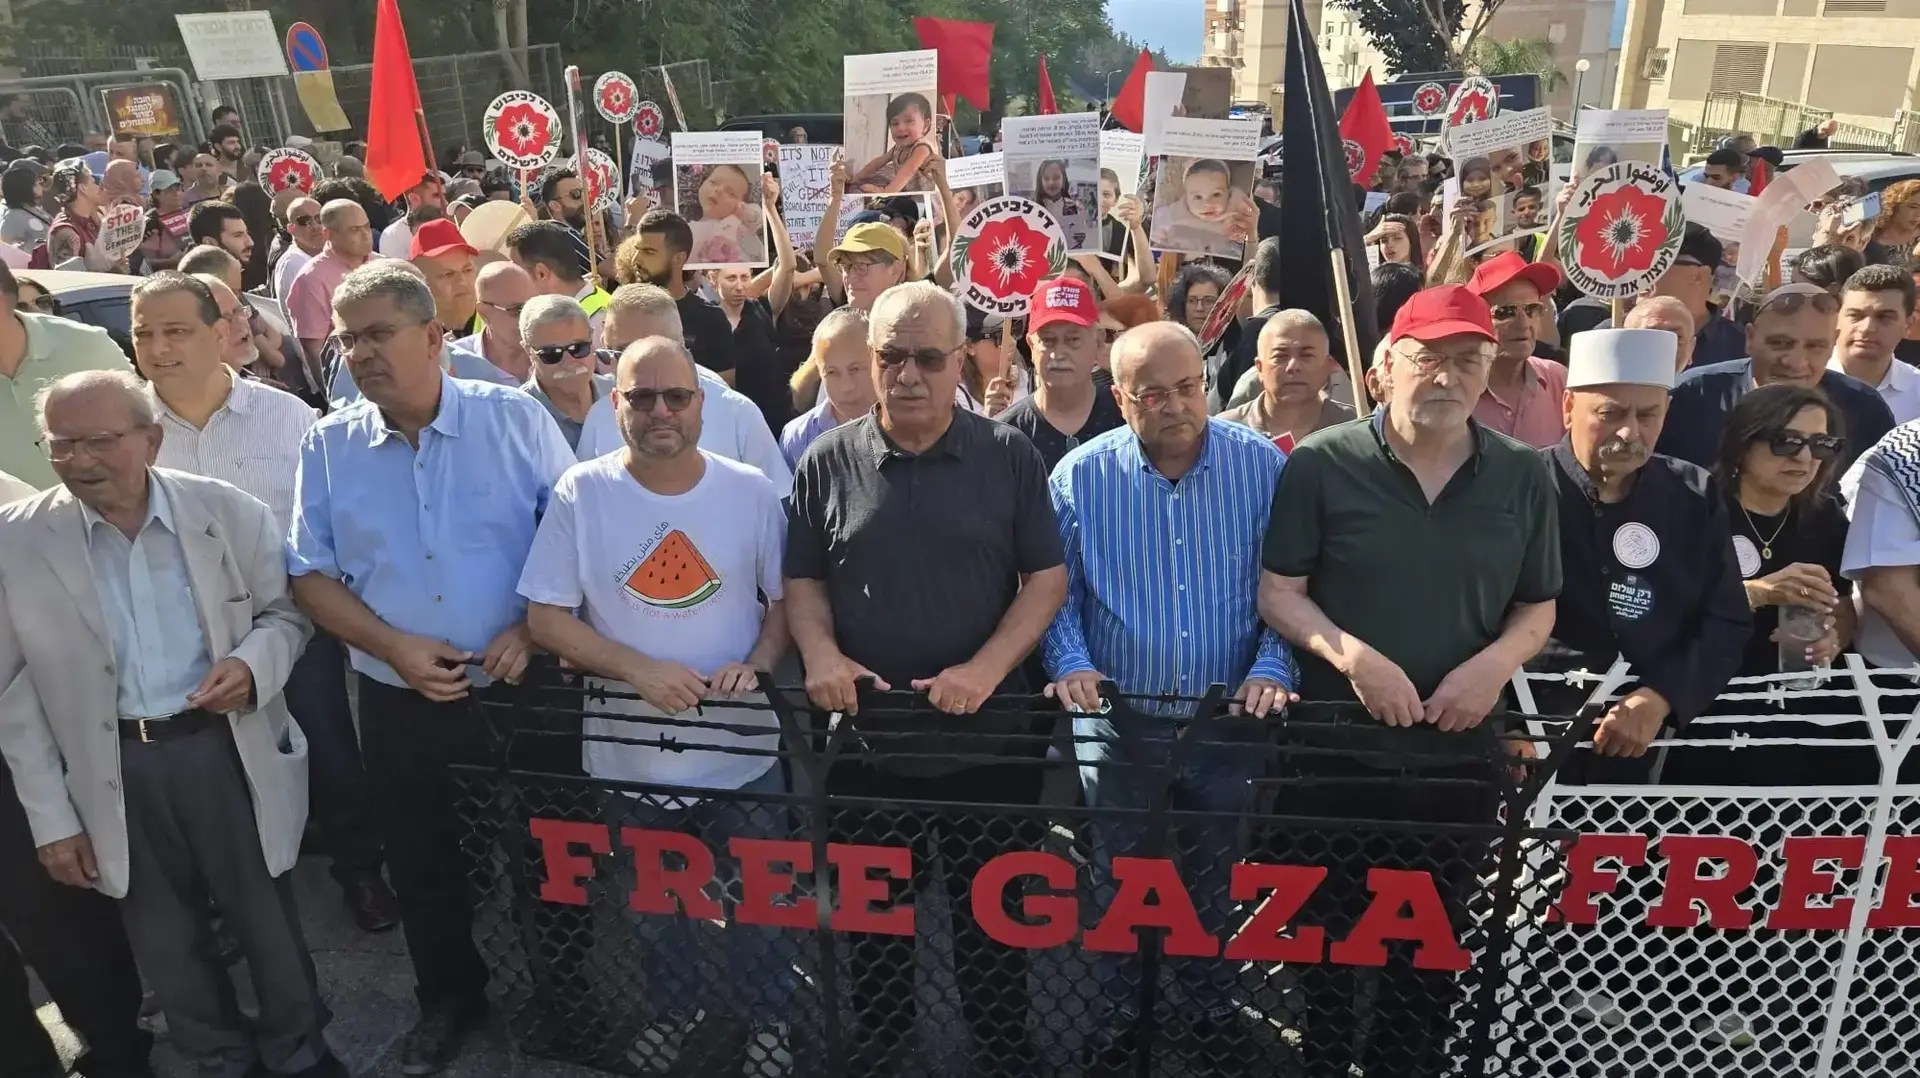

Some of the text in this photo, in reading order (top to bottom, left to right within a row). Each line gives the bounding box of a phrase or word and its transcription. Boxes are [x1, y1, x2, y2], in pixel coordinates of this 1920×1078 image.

[492, 92, 551, 112] די לכיבוש
[496, 148, 539, 167] לשלום
[540, 149, 552, 163] כן
[780, 147, 803, 162] IT'S
[810, 147, 831, 162] NOT
[1578, 164, 1620, 208] الحرب
[785, 201, 828, 212] SCHOLASTICID
[966, 200, 1055, 230] די לכיבוש
[107, 209, 140, 229] STOP
[115, 223, 134, 237] THE
[1567, 247, 1673, 298] לעצור את המלחמה
[966, 285, 1027, 313] לשלום
[1046, 298, 1080, 308] WAR
[637, 537, 654, 560] مش
[614, 557, 637, 583] بطيخة
[1611, 582, 1636, 596] שלום
[530, 818, 1472, 971] FREE GAZA
